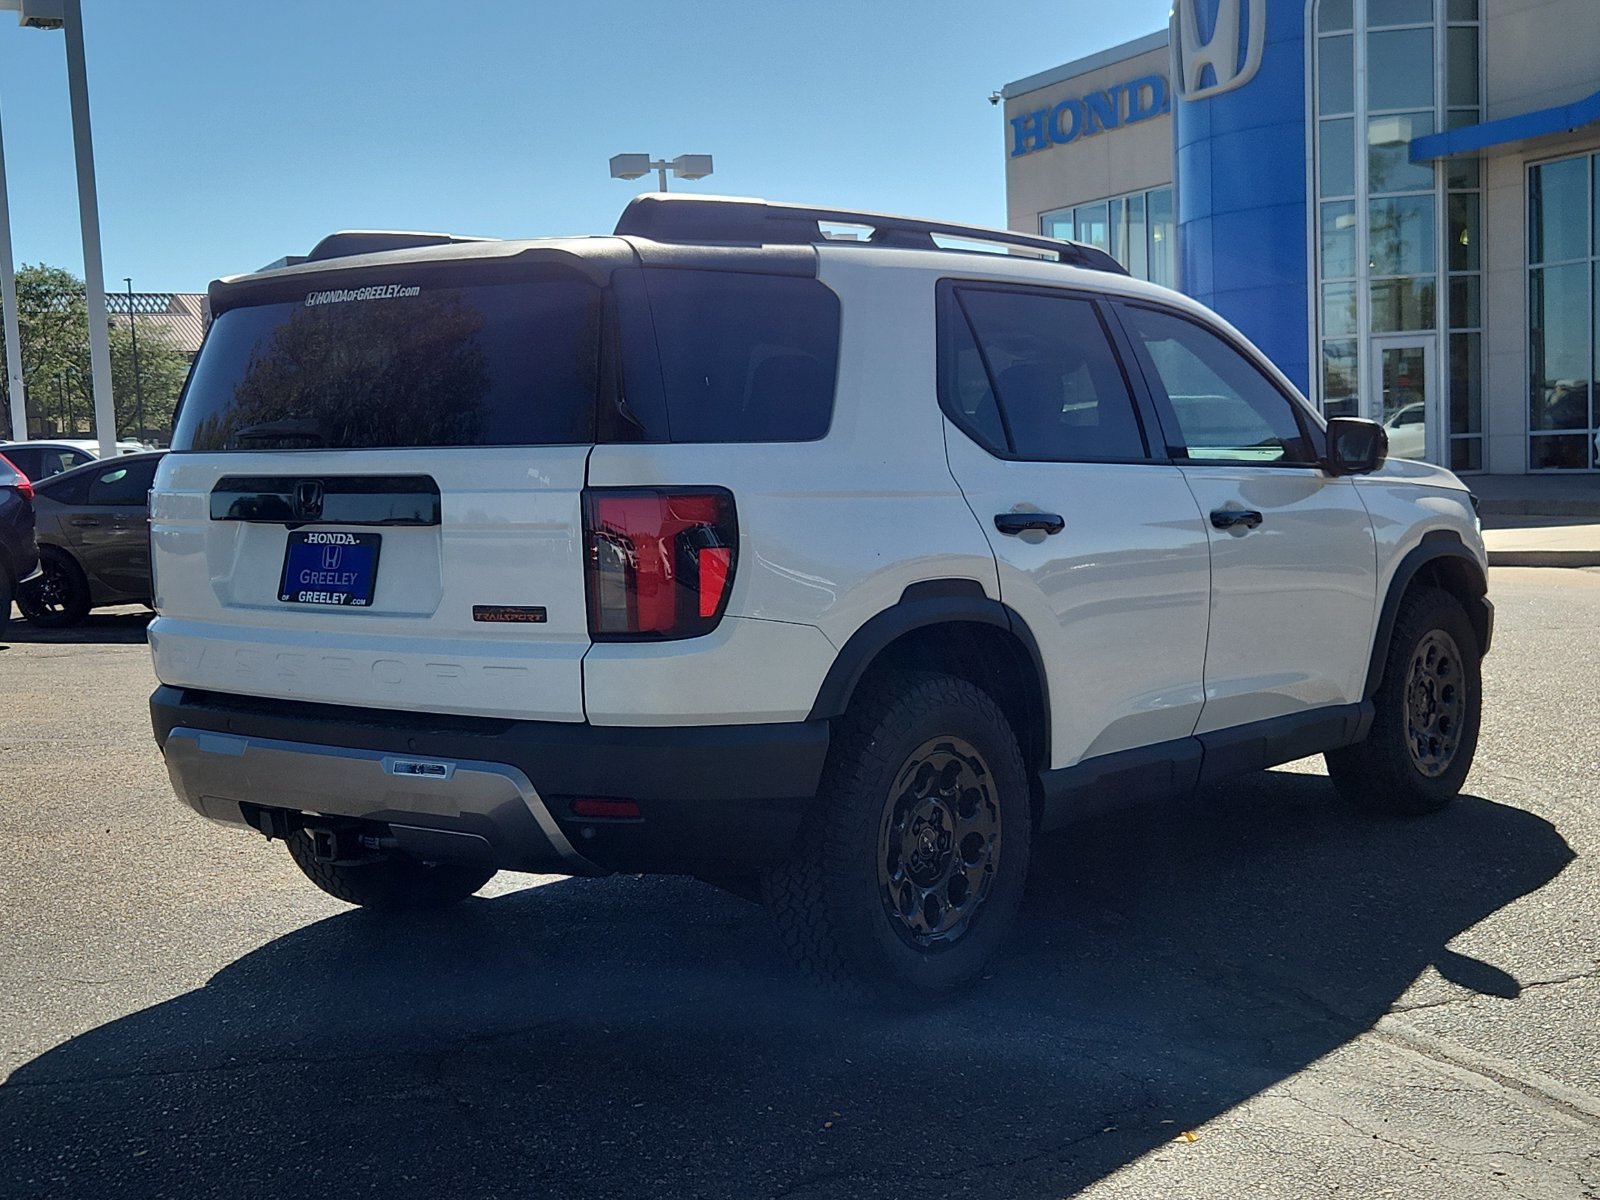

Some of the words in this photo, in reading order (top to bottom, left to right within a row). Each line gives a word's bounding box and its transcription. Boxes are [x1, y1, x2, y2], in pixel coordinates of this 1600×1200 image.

[1010, 73, 1171, 158] HOND
[307, 533, 356, 545] HONDA
[298, 591, 347, 605] GREELEY
